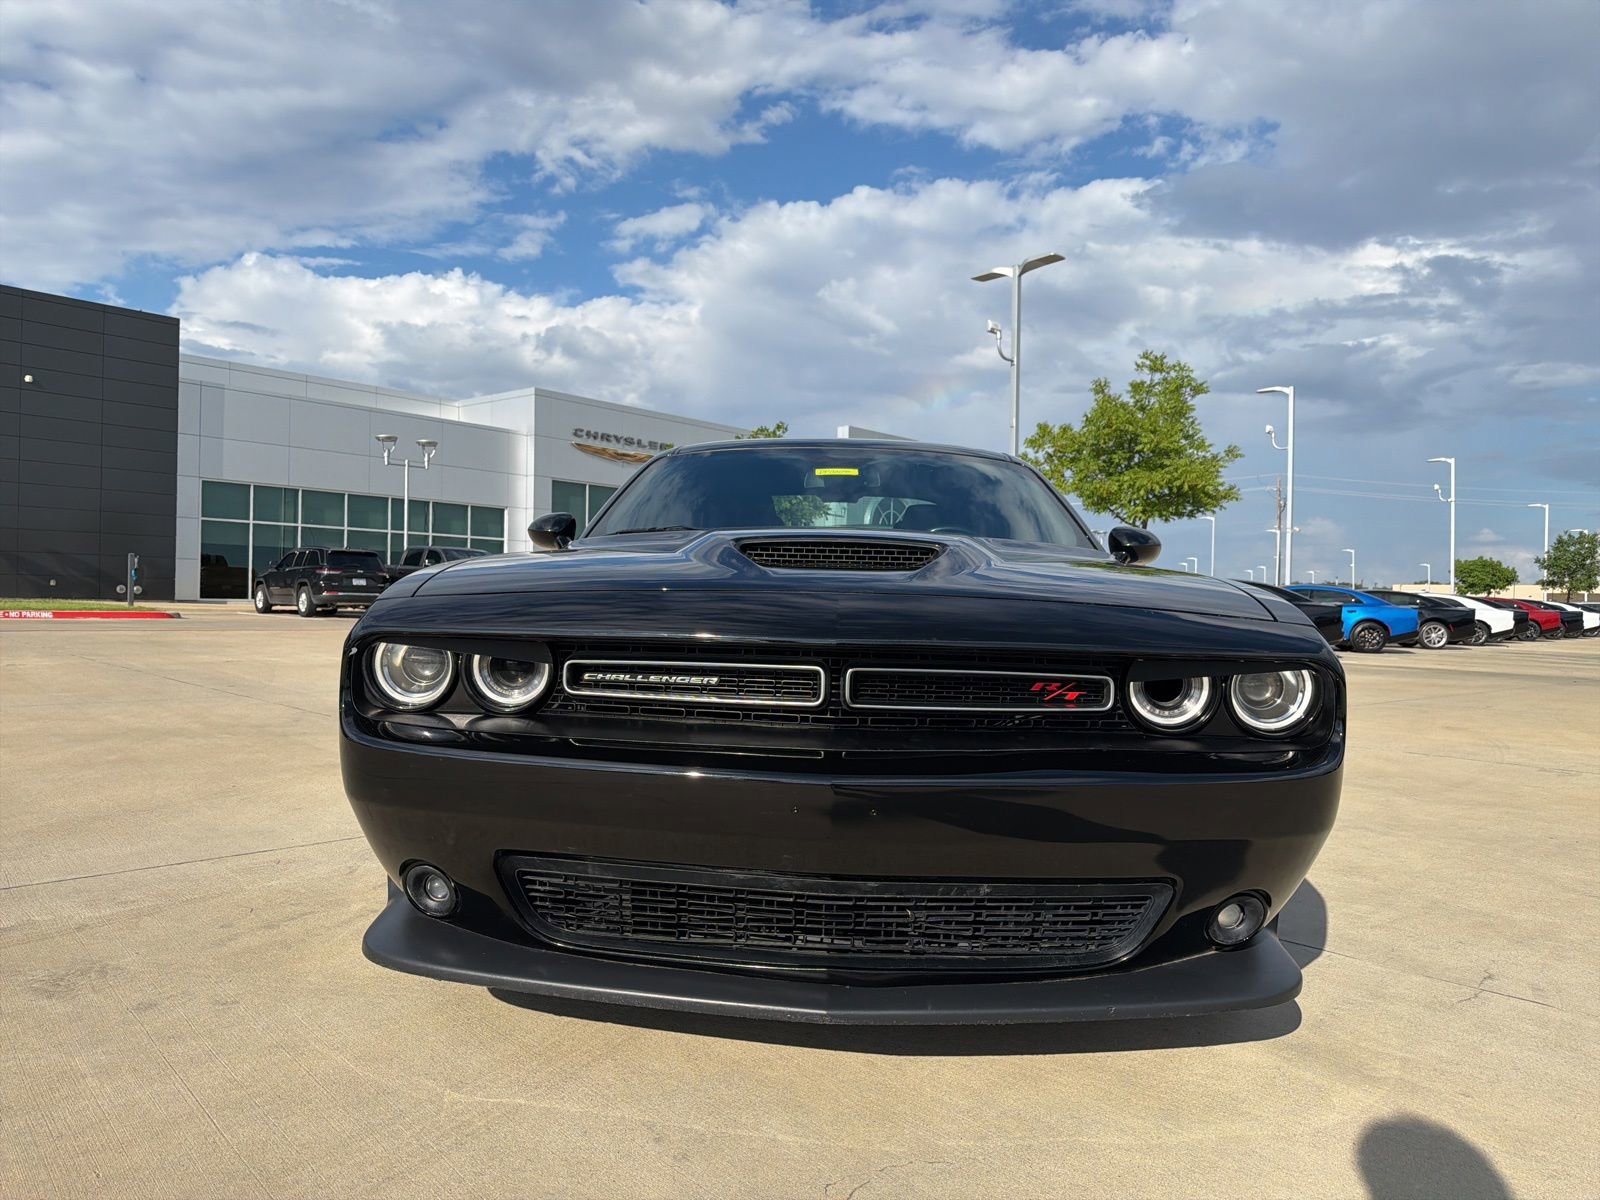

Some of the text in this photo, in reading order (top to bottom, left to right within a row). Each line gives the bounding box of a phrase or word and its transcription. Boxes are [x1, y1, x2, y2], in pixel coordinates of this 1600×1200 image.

[21, 611, 53, 619] PARKING
[583, 673, 719, 685] CHALLENGER
[1029, 682, 1087, 700] R/T
